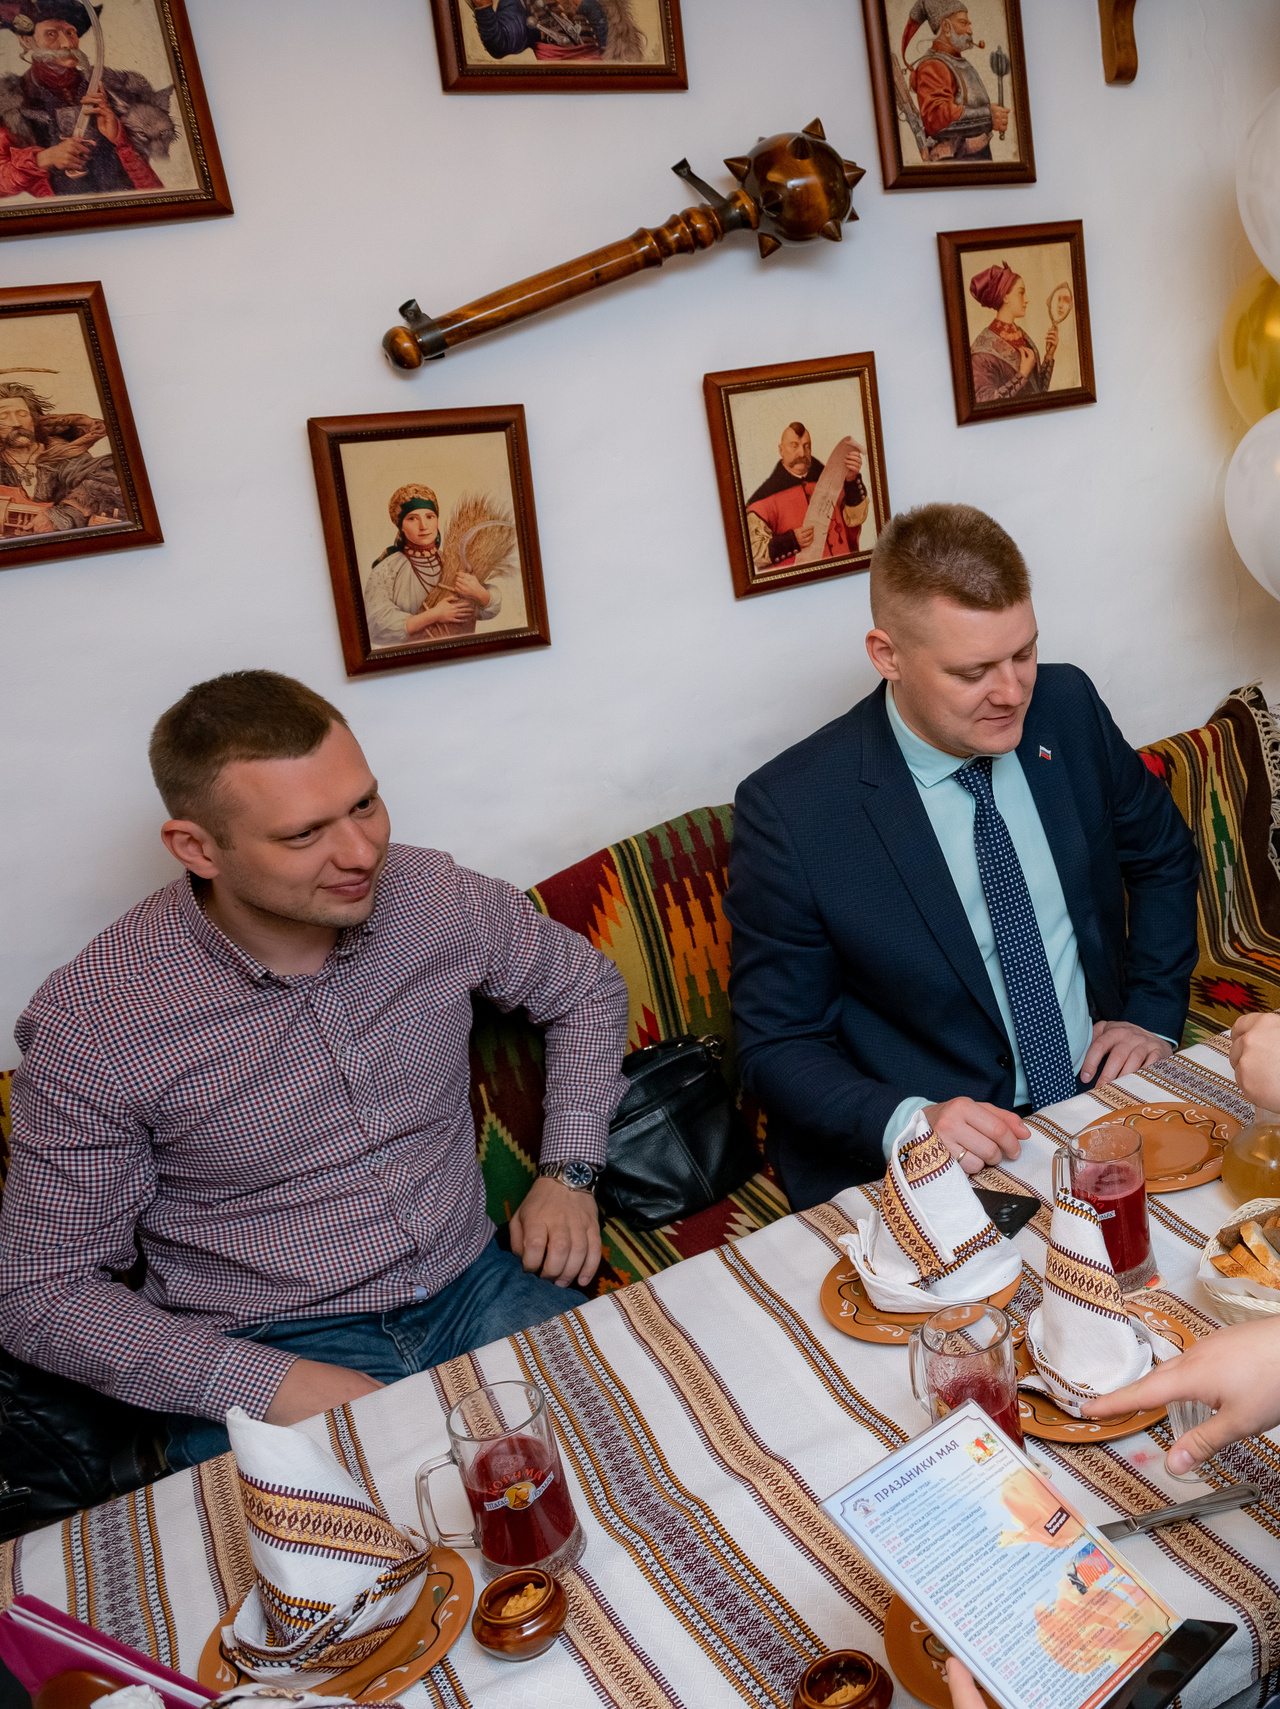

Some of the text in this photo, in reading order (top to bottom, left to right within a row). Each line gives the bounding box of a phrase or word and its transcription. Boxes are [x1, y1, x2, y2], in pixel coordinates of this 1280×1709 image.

[488, 1468, 544, 1497] КОРЧМА
[873, 1455, 937, 1502] ПРАЗДНИКИ
[879, 1501, 901, 1517] ПРАЗДНИК
[900, 1491, 915, 1503] ВЕСНЫ
[897, 1526, 910, 1537] ДЕНЬ
[908, 1518, 921, 1529] БРАТА
[923, 1504, 940, 1517] СЕСТРЫ
[868, 1523, 881, 1534] ДЕНЬ
[915, 1528, 951, 1557] МЕЖДУНАРОДНЫЙ
[949, 1521, 962, 1531] ДЕНЬ
[959, 1505, 982, 1523] ПОЖАРНЫХ
[902, 1532, 915, 1543] ДЕНЬ
[895, 1536, 931, 1564] ДЕНЬ КОНДИТЕРА
[914, 1574, 927, 1585] ДЕНЬ
[924, 1554, 951, 1577] ОБНОВЛЕНИЯ
[938, 1553, 974, 1582] МЕЖДУНАРОДНЫЙ
[973, 1545, 984, 1556] ДЕНЬ
[928, 1569, 964, 1599] МЕЖДУНАРОДНЫЙ
[963, 1561, 975, 1572] ДЕНЬ
[953, 1587, 966, 1598] ДЕНЬ
[963, 1577, 977, 1589] ГЕРБА
[962, 1578, 998, 1609] МЕЖДУНАРОДНЫЙ
[996, 1570, 1008, 1581] ДЕНЬ
[933, 1594, 945, 1605] ДЕНЬ
[962, 1626, 975, 1638] ДЕНЬ
[1000, 1585, 1023, 1605] РАБОТНИКА
[967, 1590, 1027, 1642] МЕЖДУНАРОДНЫЙ ДЕНЬ МАТЕРИ
[972, 1600, 993, 1618] ЖЕНСКИЙ
[953, 1615, 965, 1627] ДЕНЬ
[986, 1624, 999, 1635] ДЕНЬ
[998, 1632, 1010, 1643] ДЕНЬ
[989, 1655, 1002, 1667] ДЕНЬ
[1019, 1655, 1031, 1666] ДЕНЬ
[1037, 1661, 1049, 1673] ДЕНЬ
[1089, 1665, 1101, 1677] ДЕНЬ
[1040, 1677, 1052, 1689] ДЕНЬ
[1049, 1677, 1061, 1688] ДЕНЬ
[1018, 1687, 1030, 1699] ДЕНЬ
[1048, 1686, 1060, 1698] ДЕНЬ
